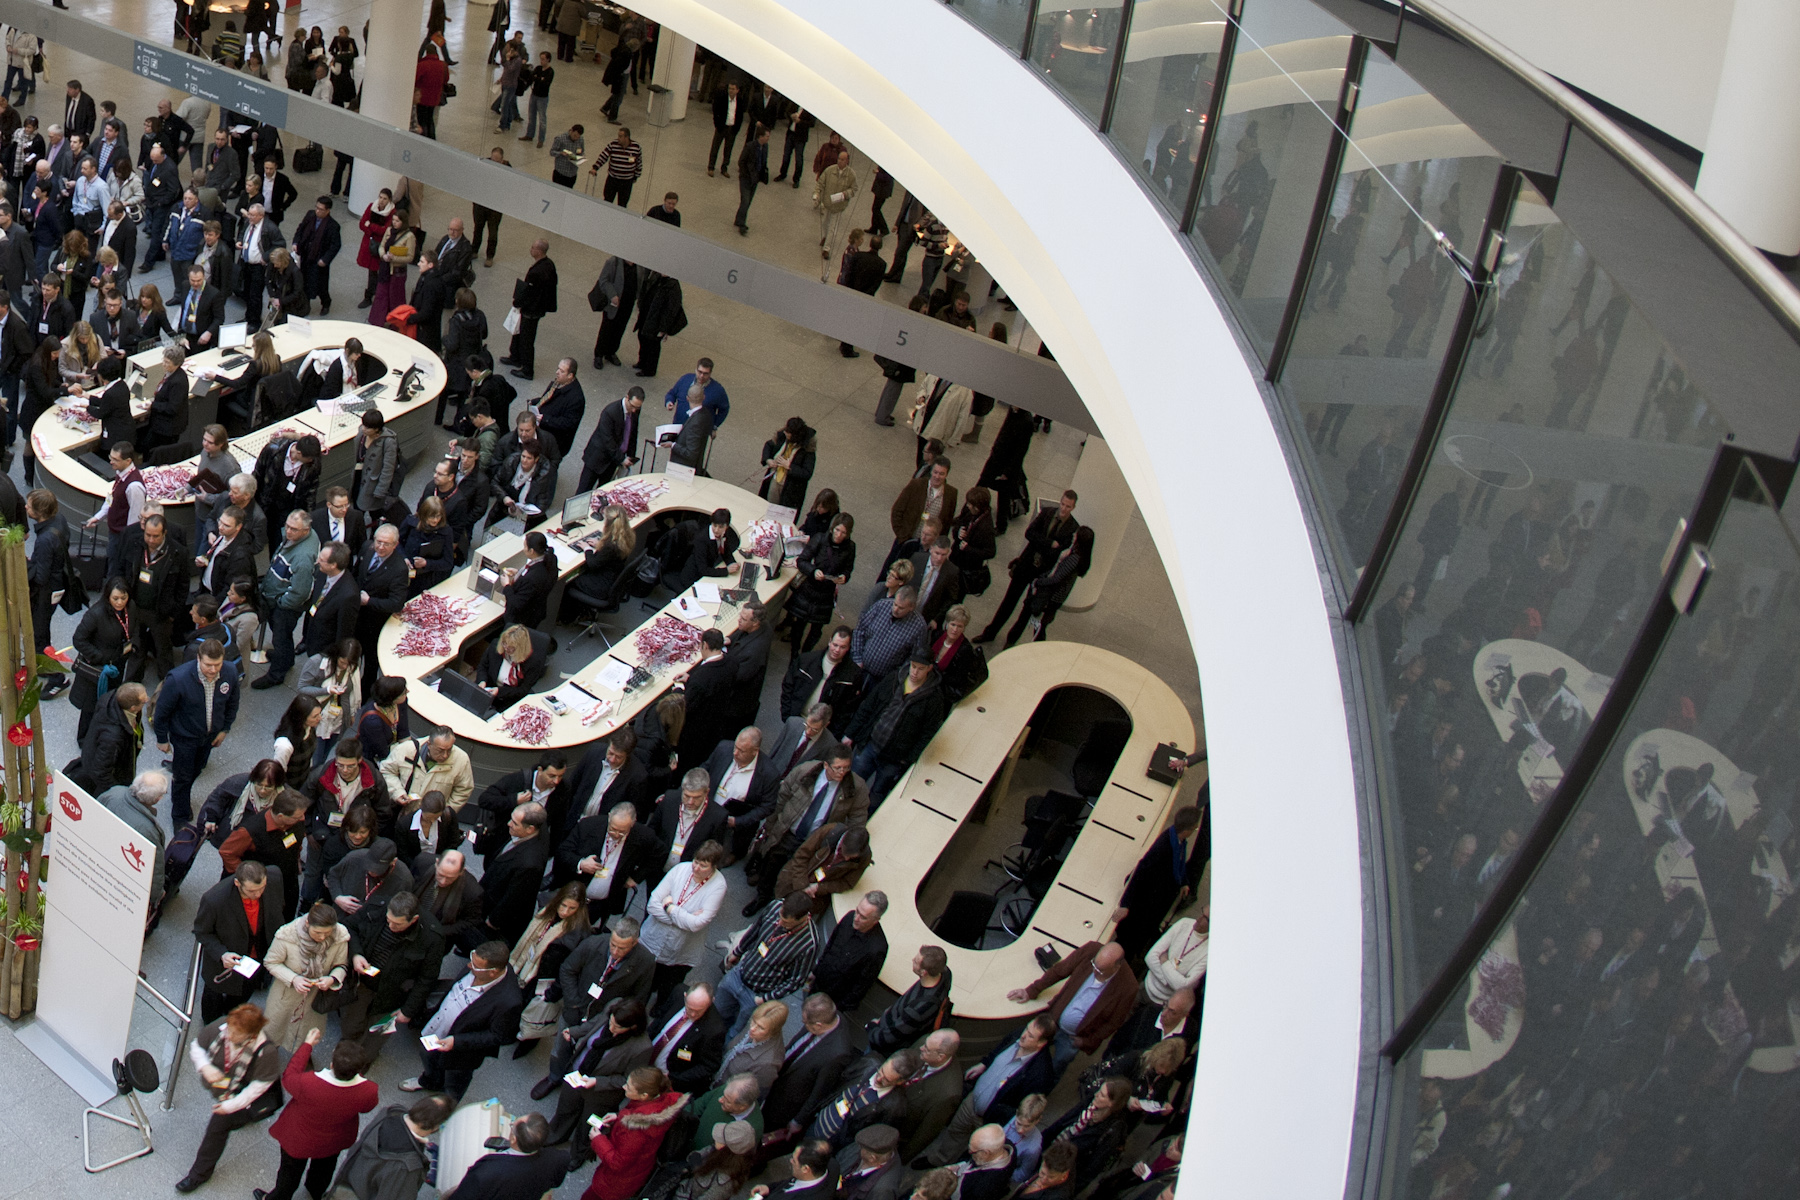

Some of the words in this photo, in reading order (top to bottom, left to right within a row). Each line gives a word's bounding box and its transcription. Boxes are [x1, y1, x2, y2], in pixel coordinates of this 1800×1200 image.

[402, 150, 411, 163] 8
[542, 199, 550, 213] 7
[727, 269, 738, 284] 6
[896, 330, 908, 346] 5
[60, 796, 81, 816] STOP
